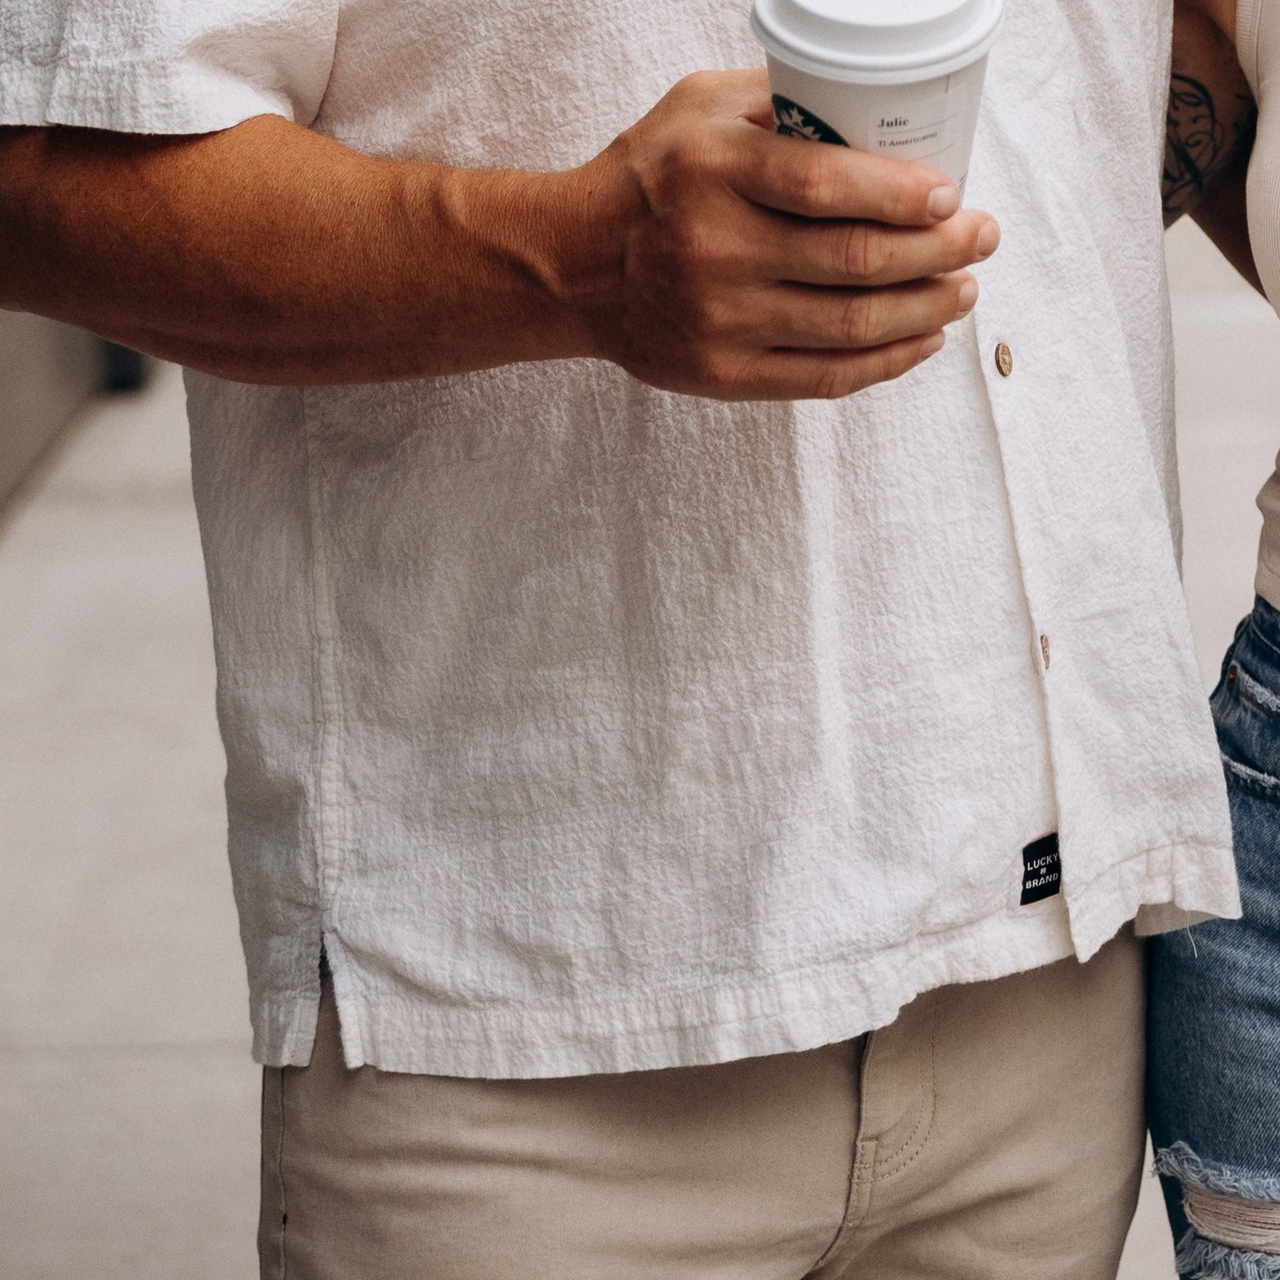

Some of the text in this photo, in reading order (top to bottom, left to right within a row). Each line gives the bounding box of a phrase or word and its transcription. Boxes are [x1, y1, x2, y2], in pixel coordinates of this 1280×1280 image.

[888, 132, 938, 147] Americano
[1027, 853, 1058, 871] LUCKY
[1025, 873, 1059, 889] BRAND
